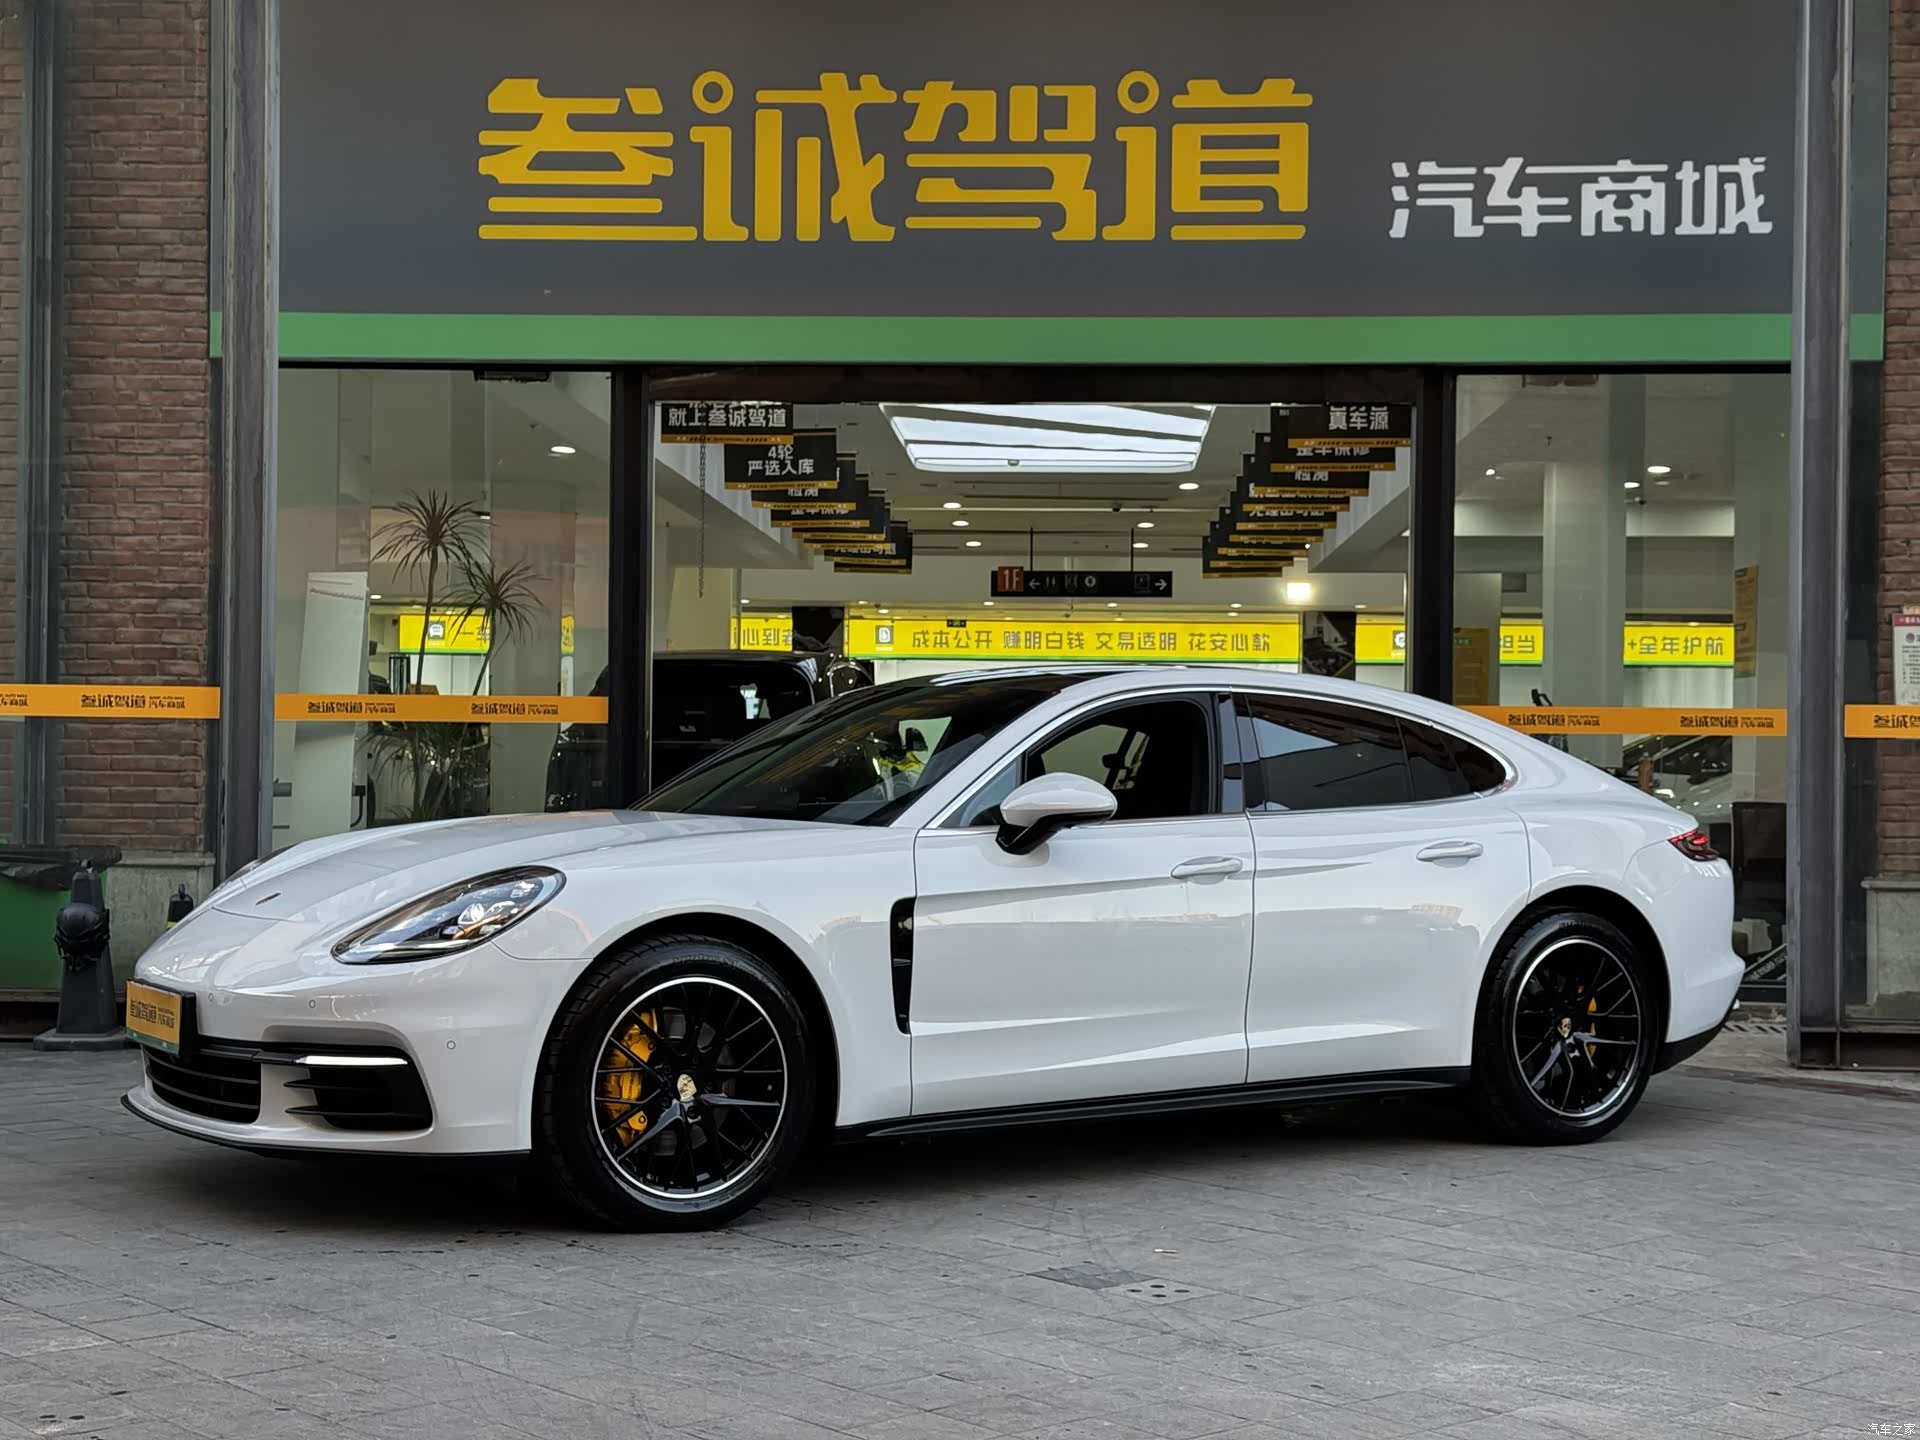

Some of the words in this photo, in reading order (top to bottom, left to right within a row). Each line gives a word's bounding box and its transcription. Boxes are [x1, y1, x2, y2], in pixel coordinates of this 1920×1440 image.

[478, 70, 1313, 242] 叁诚驾道
[1388, 156, 1774, 239] 汽车商城
[668, 408, 786, 427] 就上叁诚驾道
[748, 459, 814, 476] 严选入库
[1003, 568, 1020, 591] 1F
[912, 630, 992, 649] 成本公开
[1003, 630, 1085, 650] 赚明白钱
[1095, 631, 1177, 651] 交易透明
[1188, 632, 1270, 653] 花安心款
